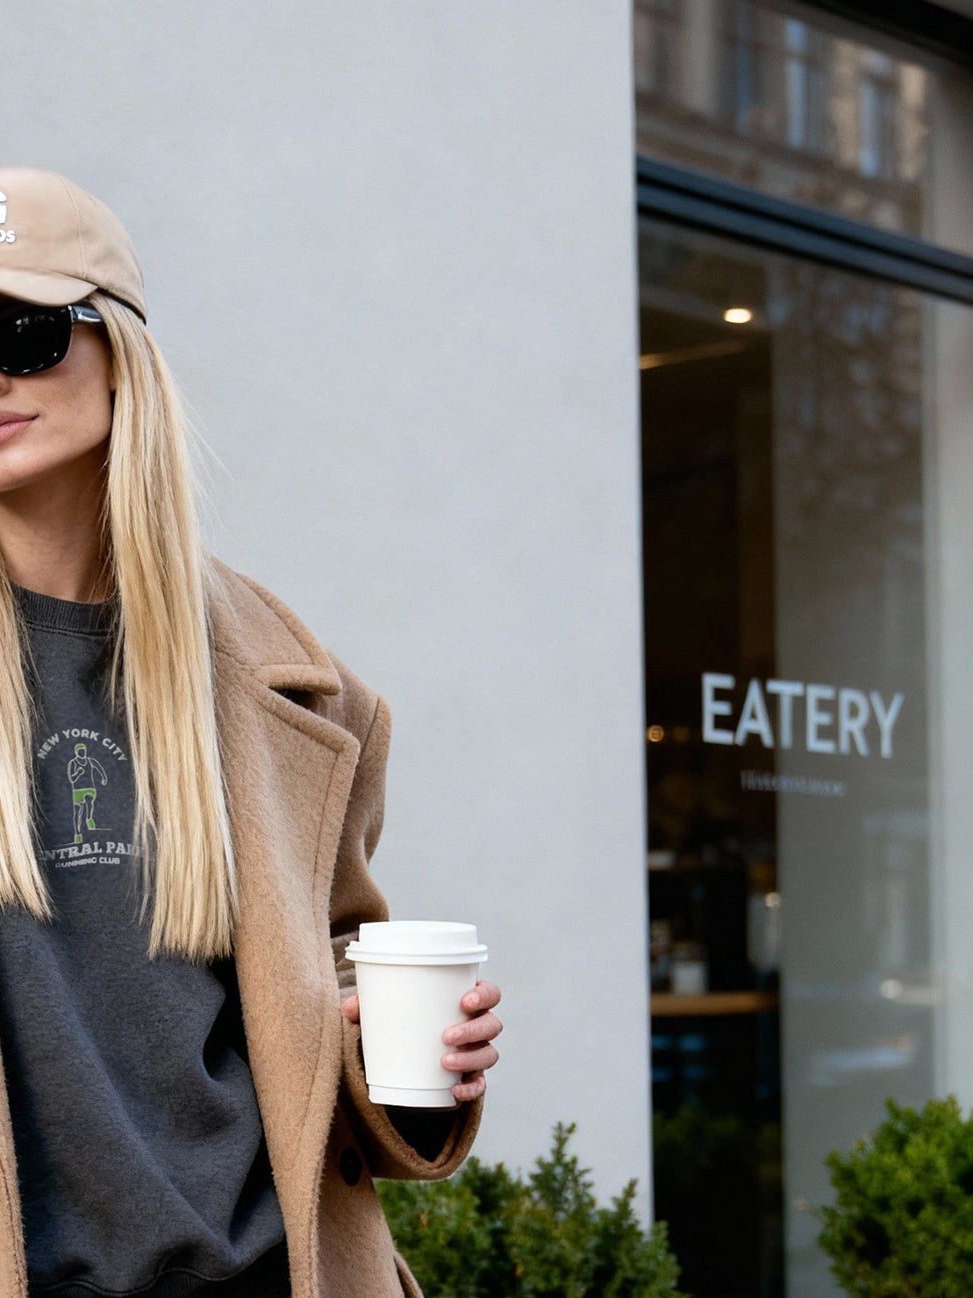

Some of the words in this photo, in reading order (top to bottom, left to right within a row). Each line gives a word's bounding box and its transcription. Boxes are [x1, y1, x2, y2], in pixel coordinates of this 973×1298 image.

[701, 671, 905, 760] EATERY
[37, 733, 60, 760] NEW
[62, 728, 100, 741] YORK
[102, 737, 128, 762] CITY
[41, 842, 102, 860] NTRAL
[99, 856, 121, 865] CLUB
